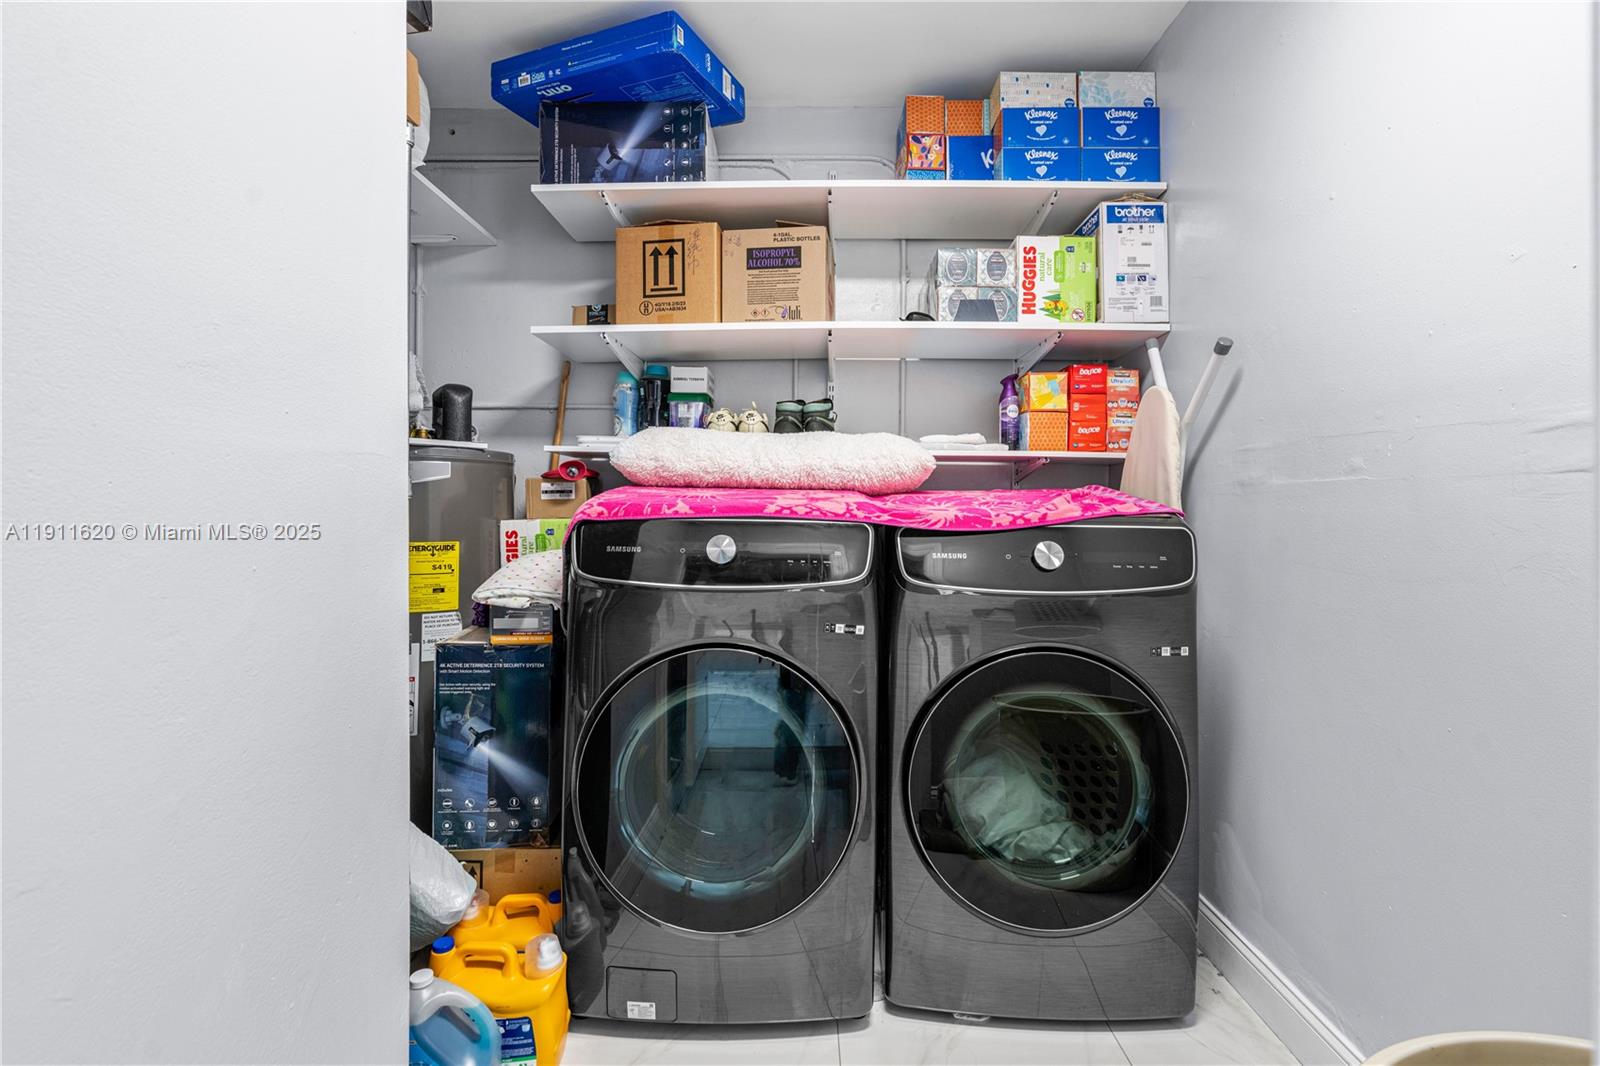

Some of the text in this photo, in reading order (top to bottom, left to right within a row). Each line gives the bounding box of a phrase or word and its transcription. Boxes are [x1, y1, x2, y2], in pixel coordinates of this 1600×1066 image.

[1024, 108, 1058, 120] Kleenex
[1104, 108, 1138, 120] Kleenex
[1024, 149, 1058, 161] Kleenex
[1104, 150, 1138, 162] Kleenex
[1114, 206, 1156, 217] brother
[752, 248, 796, 258] ISOPROPYL
[748, 258, 800, 268] ALCOHOL 70%
[1022, 246, 1037, 314] HUGGIES
[1078, 426, 1101, 434] bounce
[932, 552, 968, 560] SAMSUNG
